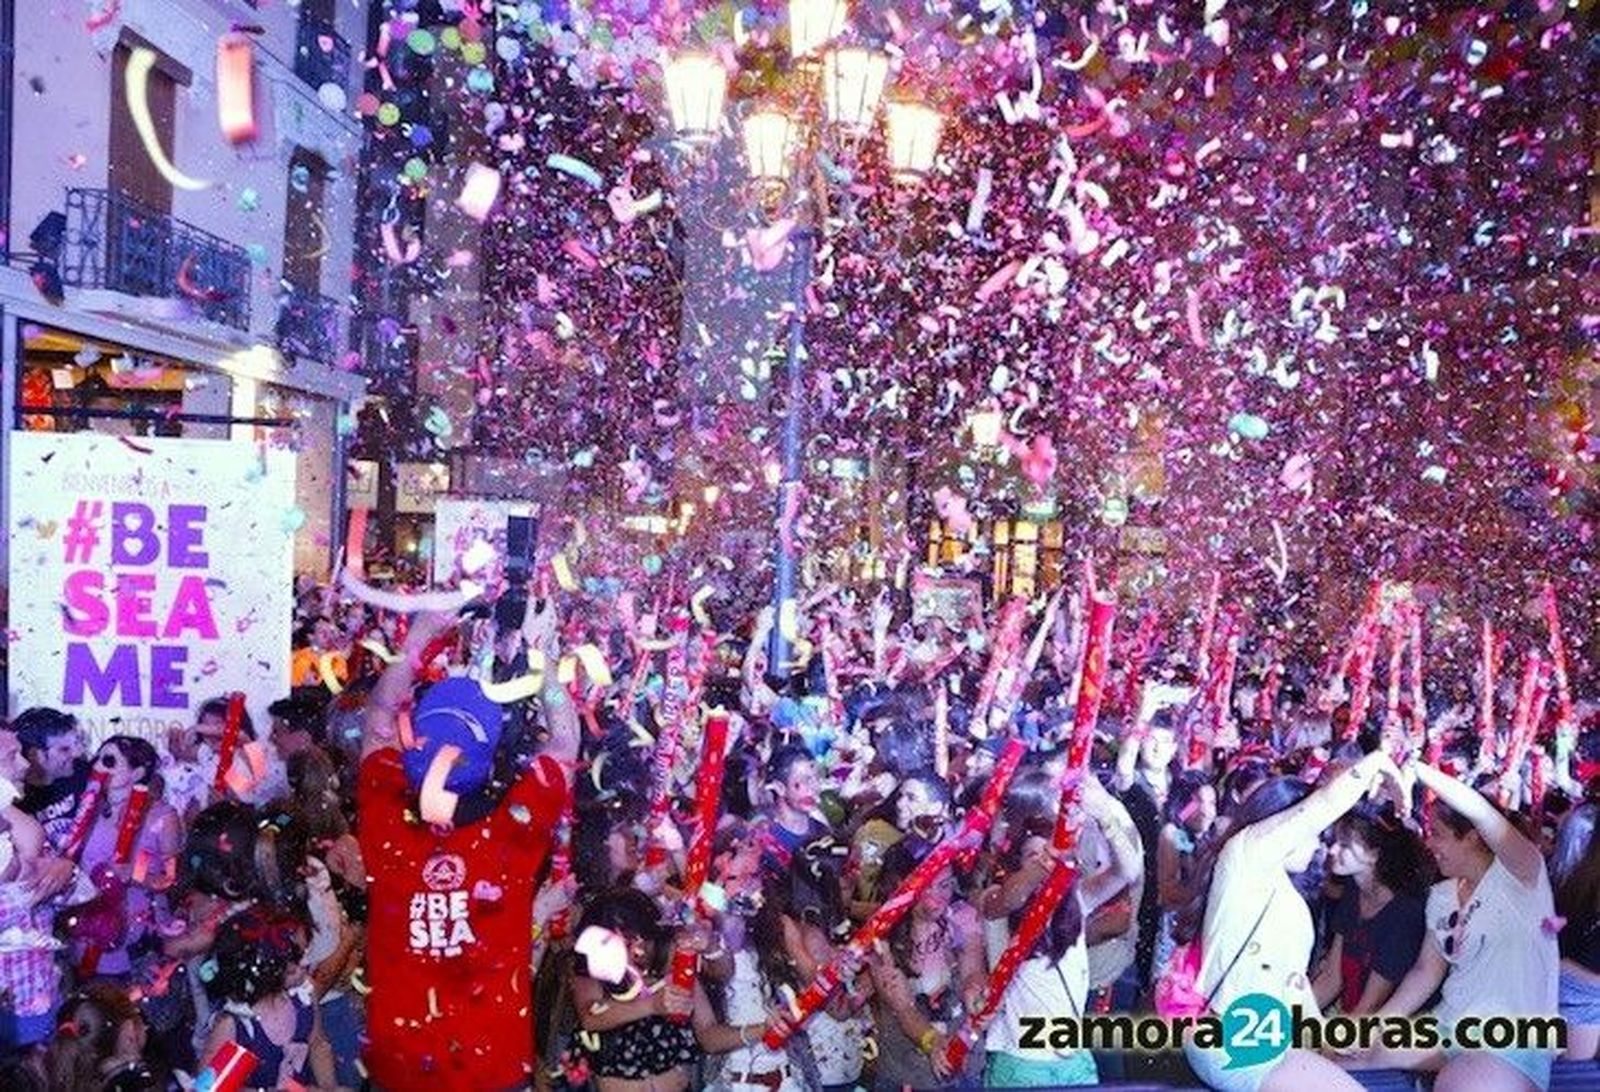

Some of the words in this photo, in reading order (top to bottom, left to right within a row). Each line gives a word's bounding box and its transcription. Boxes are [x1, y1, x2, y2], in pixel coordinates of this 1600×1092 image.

[63, 500, 209, 568] #BE
[62, 570, 219, 639] SEA
[62, 642, 189, 708] ME
[409, 891, 469, 920] #BE
[409, 919, 476, 948] SEA
